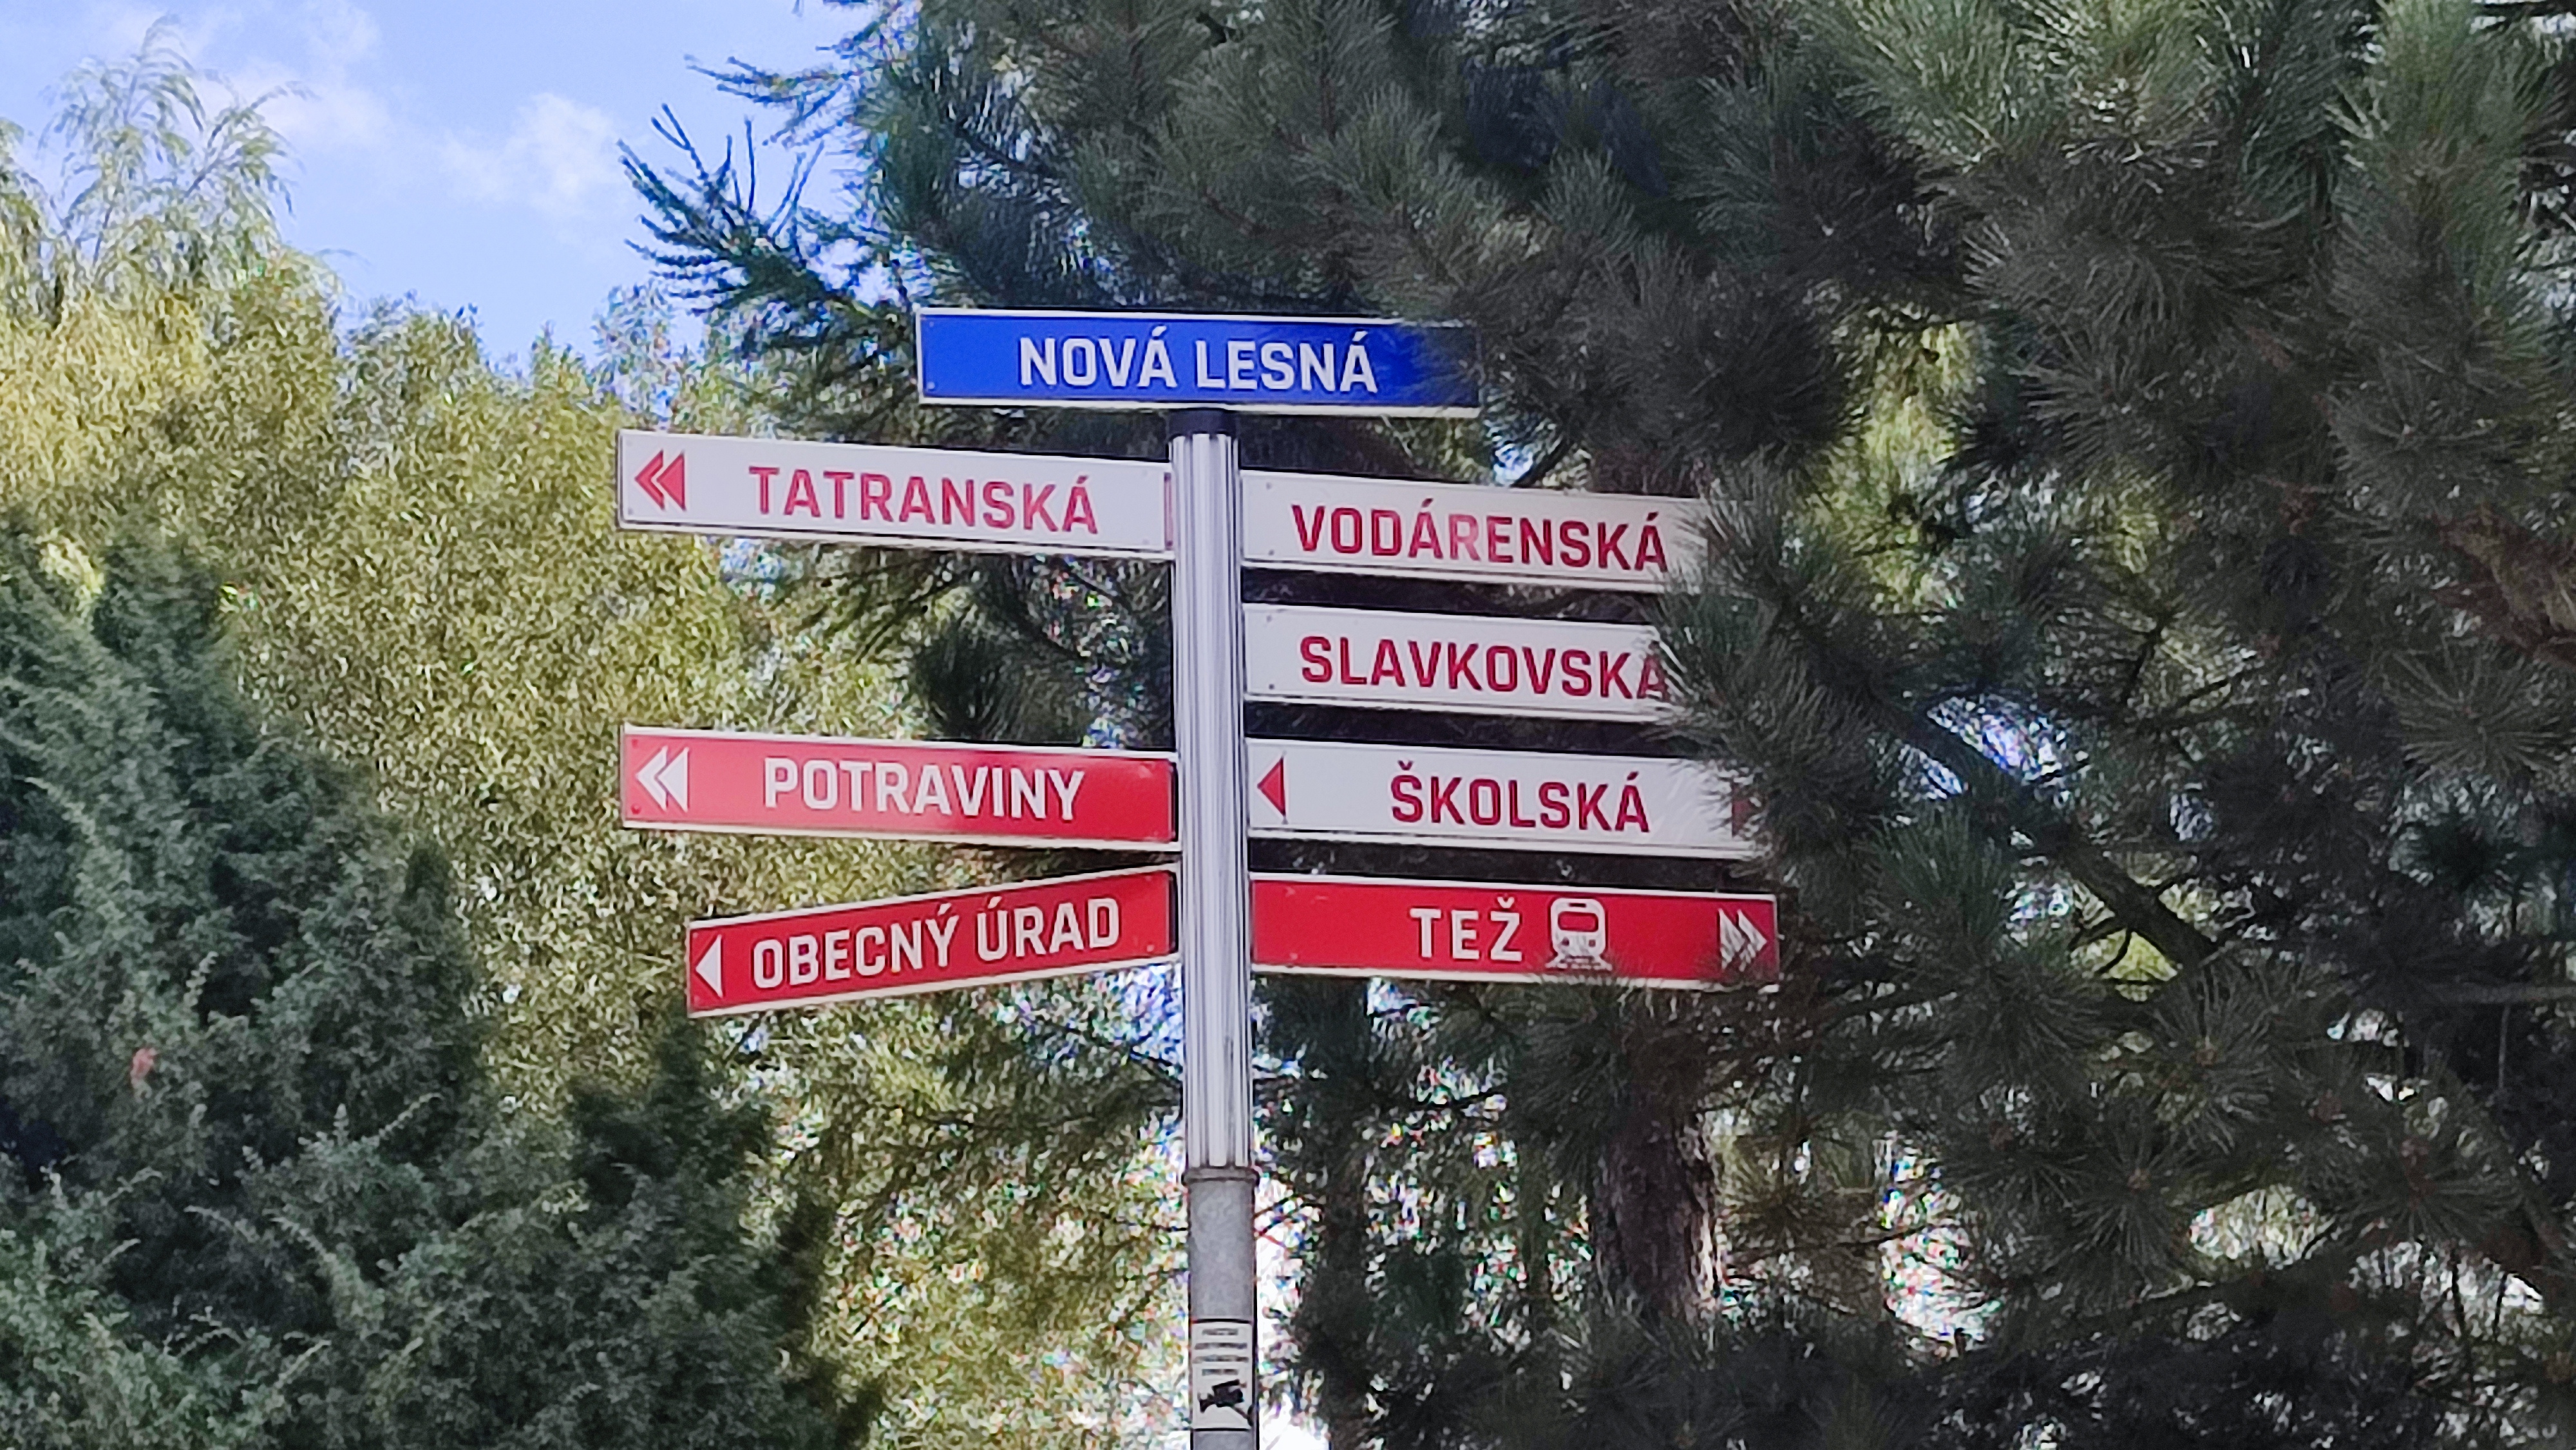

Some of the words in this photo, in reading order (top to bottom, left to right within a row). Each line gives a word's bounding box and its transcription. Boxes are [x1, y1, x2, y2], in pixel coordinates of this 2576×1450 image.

[1019, 326, 1177, 388] NOVÁ
[1196, 332, 1378, 393] LESNÁ
[749, 466, 1097, 534] TATRANSKÁ
[1291, 498, 1669, 572] VODÁRENSKÁ
[764, 758, 1084, 820] POTRAVINY
[1392, 760, 1650, 833] ŠKOLSKÁ
[754, 904, 959, 989] OBECNÝ
[974, 896, 1120, 961] ÚRAD
[1410, 896, 1523, 962] TEŽ
